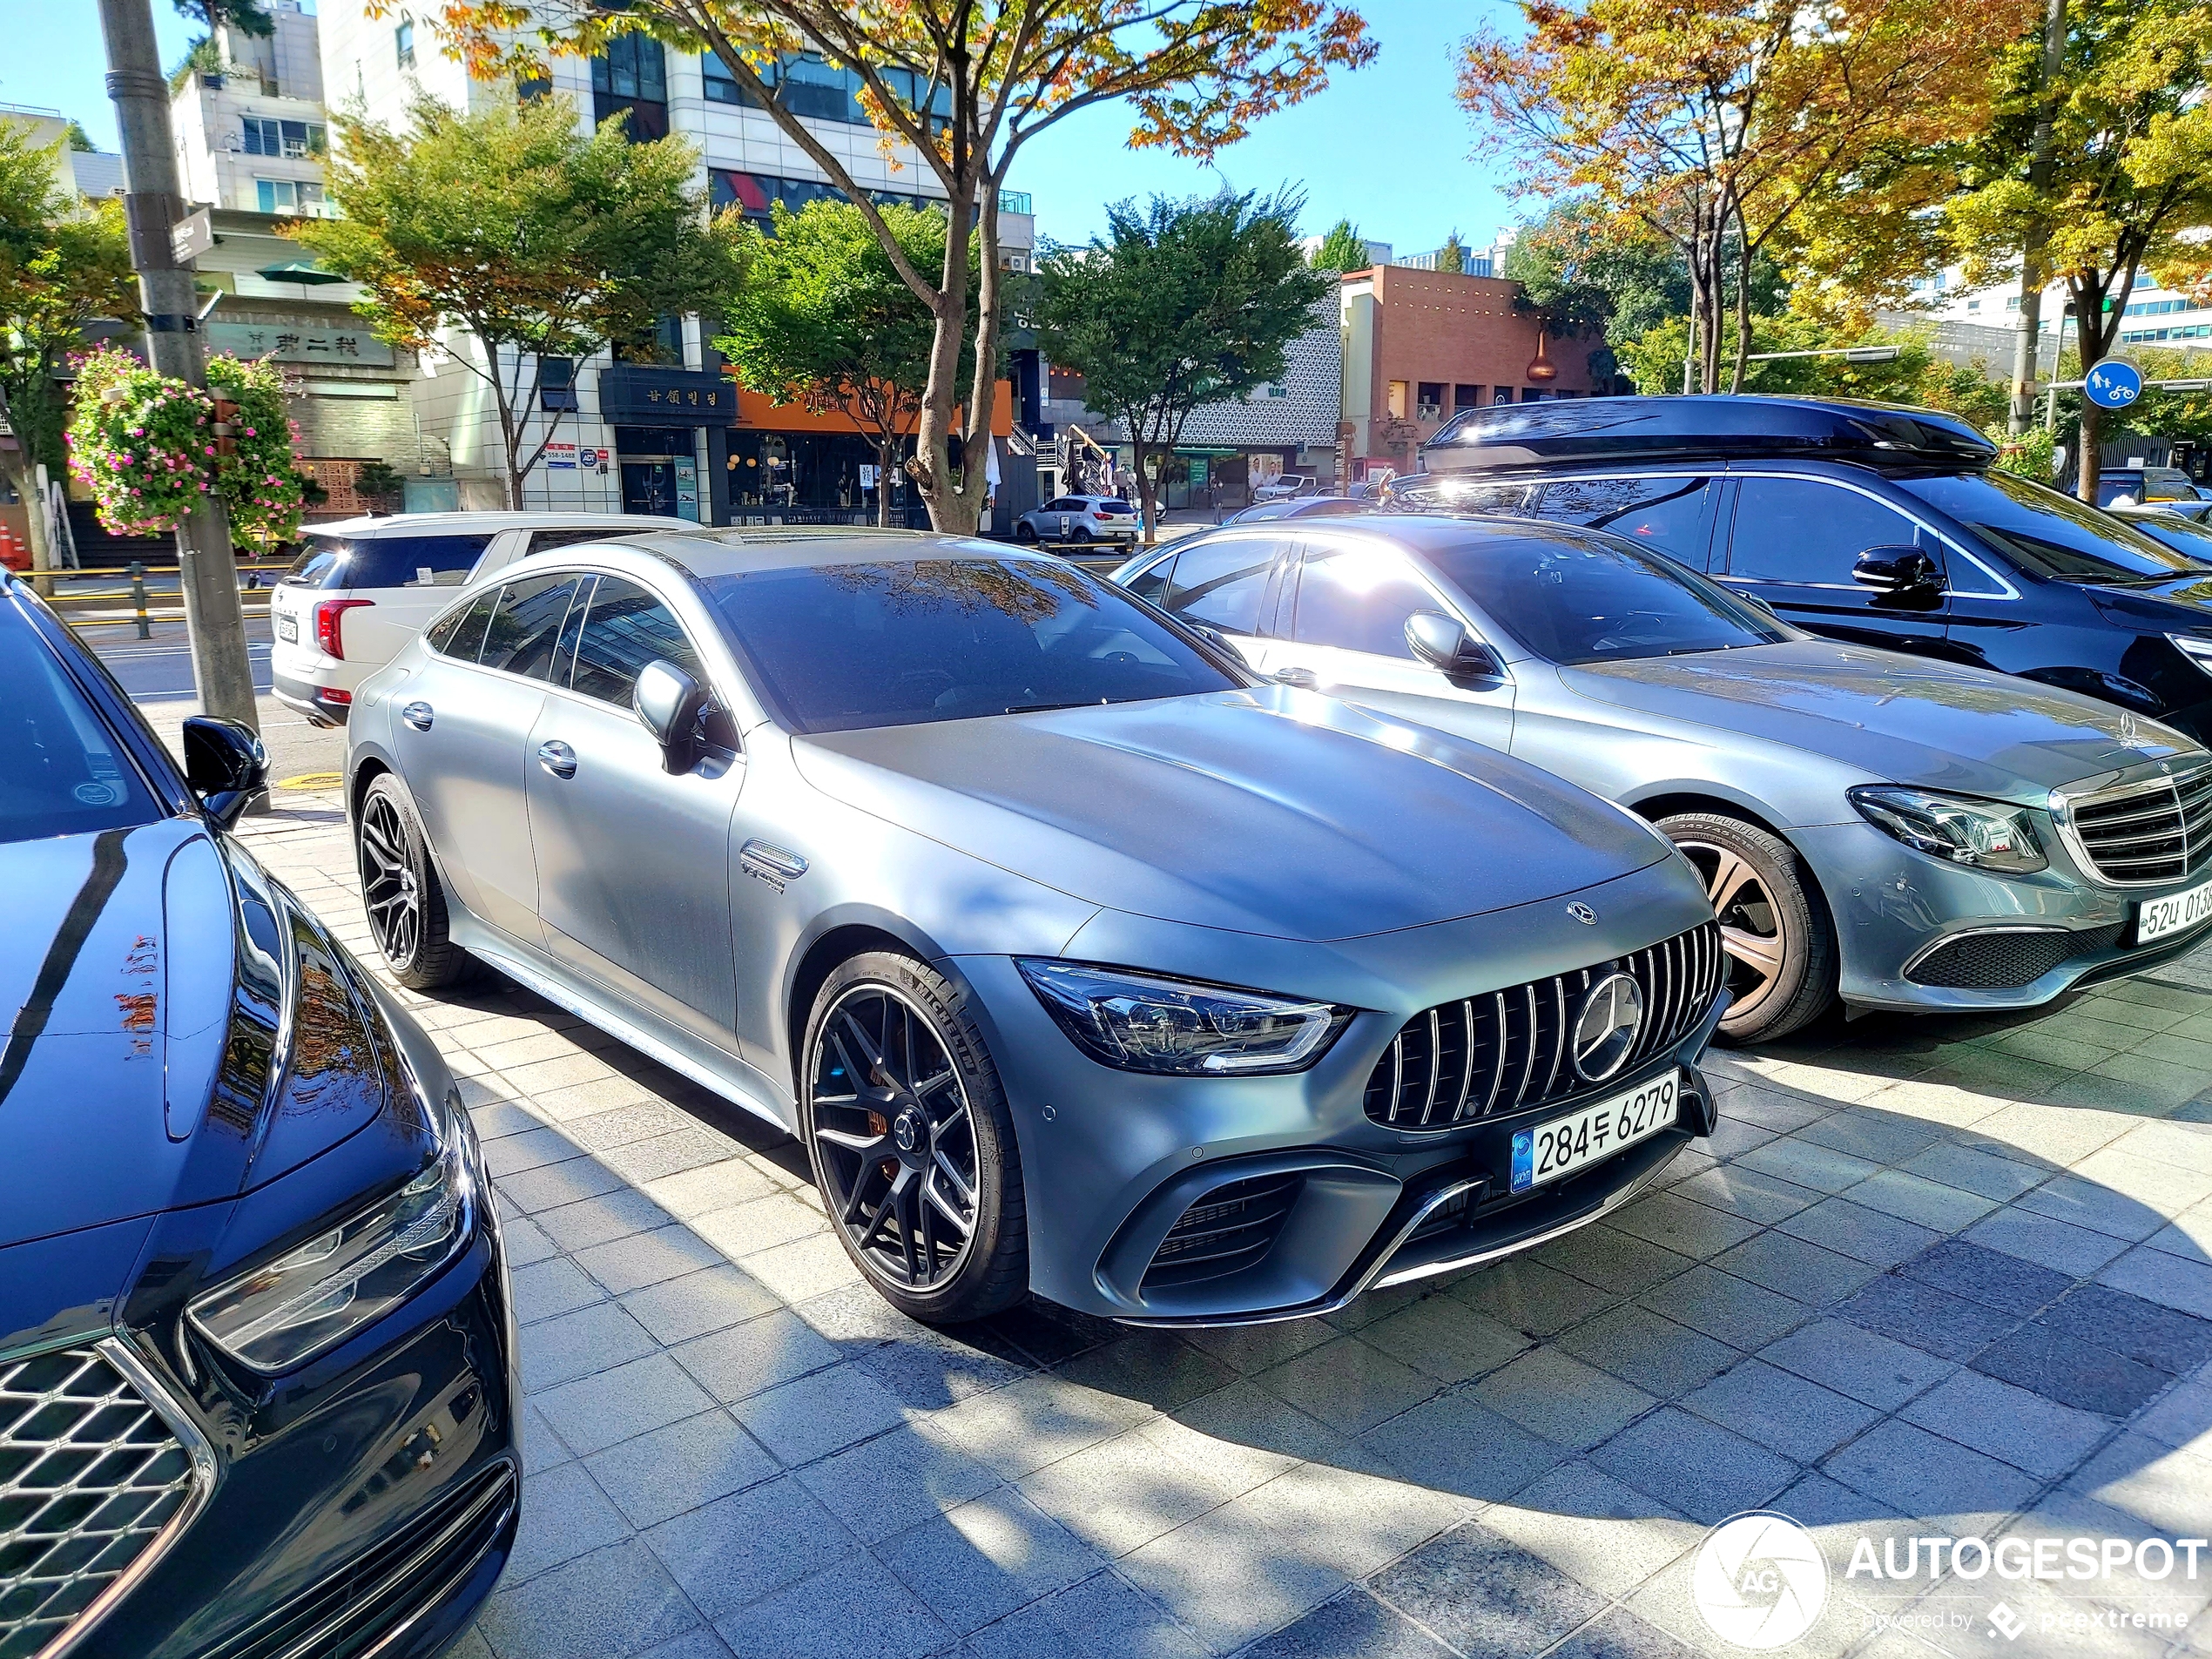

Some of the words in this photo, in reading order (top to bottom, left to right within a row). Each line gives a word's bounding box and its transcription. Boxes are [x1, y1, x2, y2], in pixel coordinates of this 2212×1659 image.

[915, 983, 975, 1071] MICHELIN
[1537, 1110, 1610, 1176] 284두
[1616, 1080, 1675, 1141] 6279
